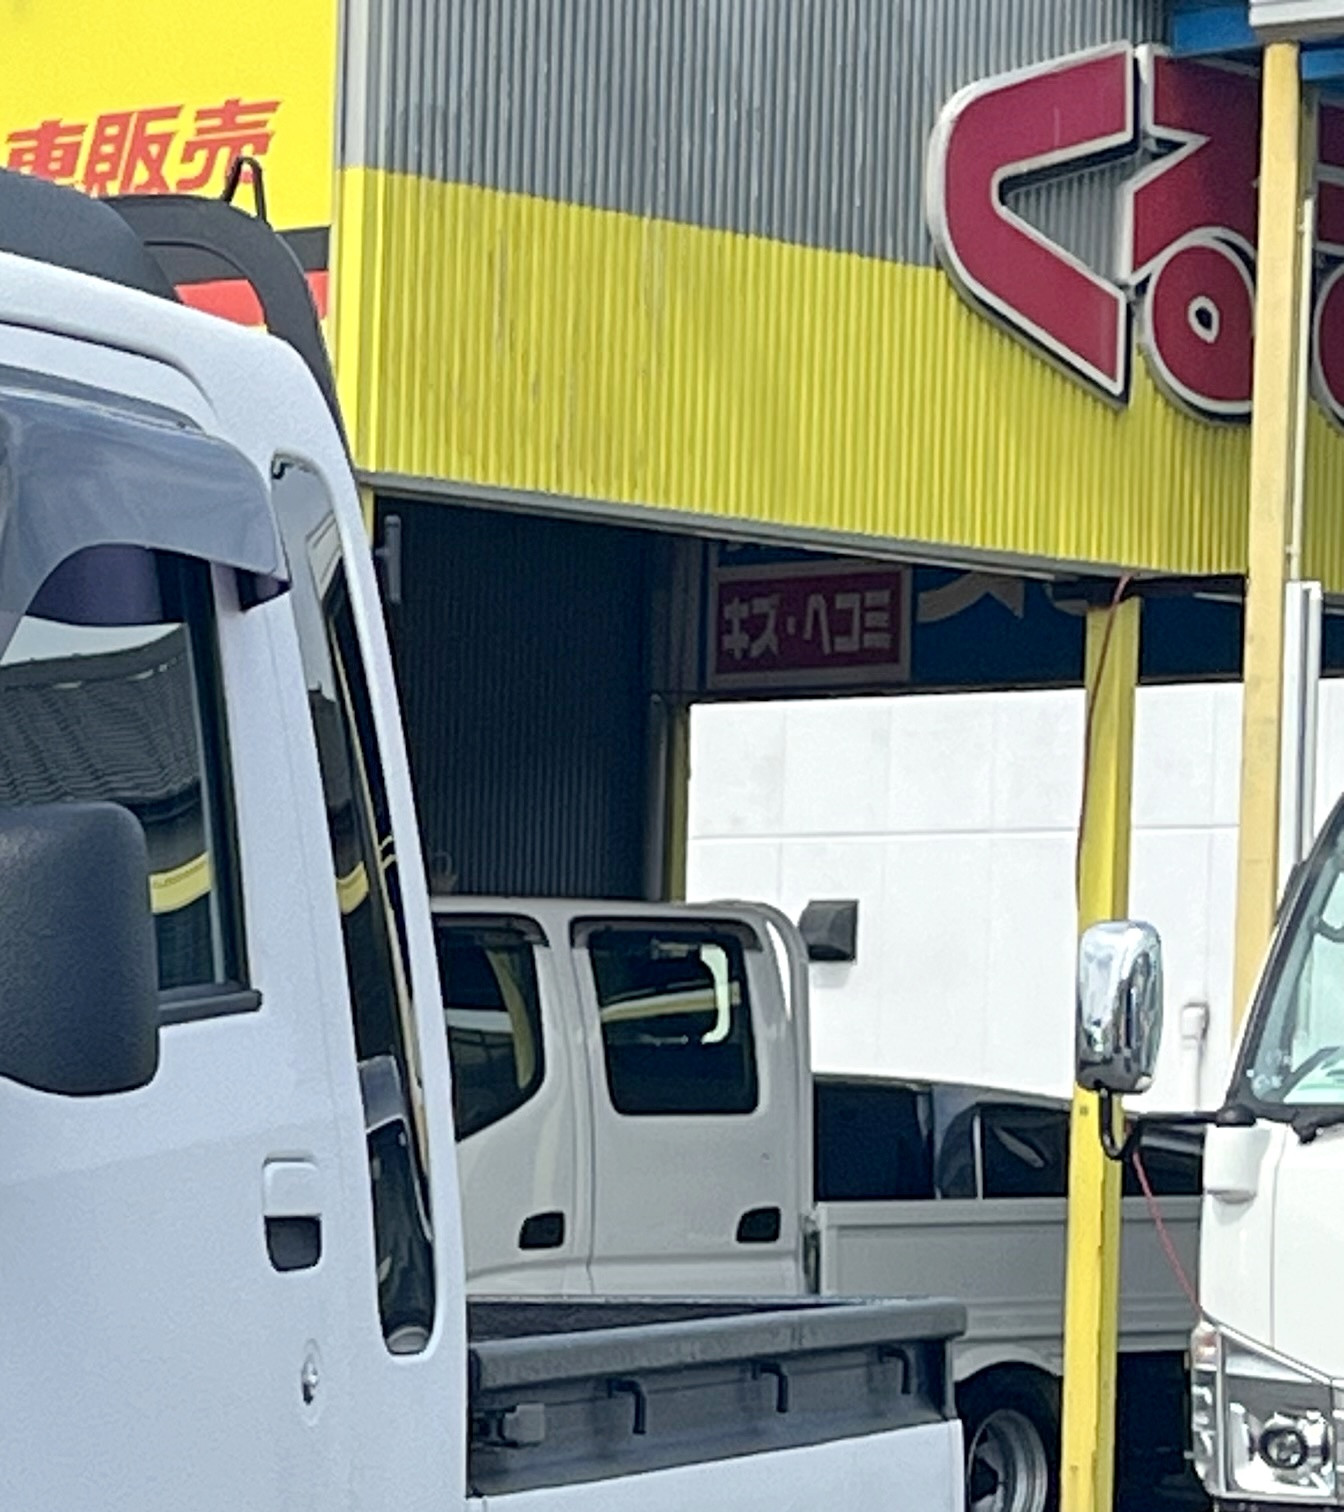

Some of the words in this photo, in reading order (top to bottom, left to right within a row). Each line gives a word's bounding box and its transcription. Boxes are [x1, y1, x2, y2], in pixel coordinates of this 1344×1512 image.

[722, 588, 893, 661] キズ・ヘコミ
